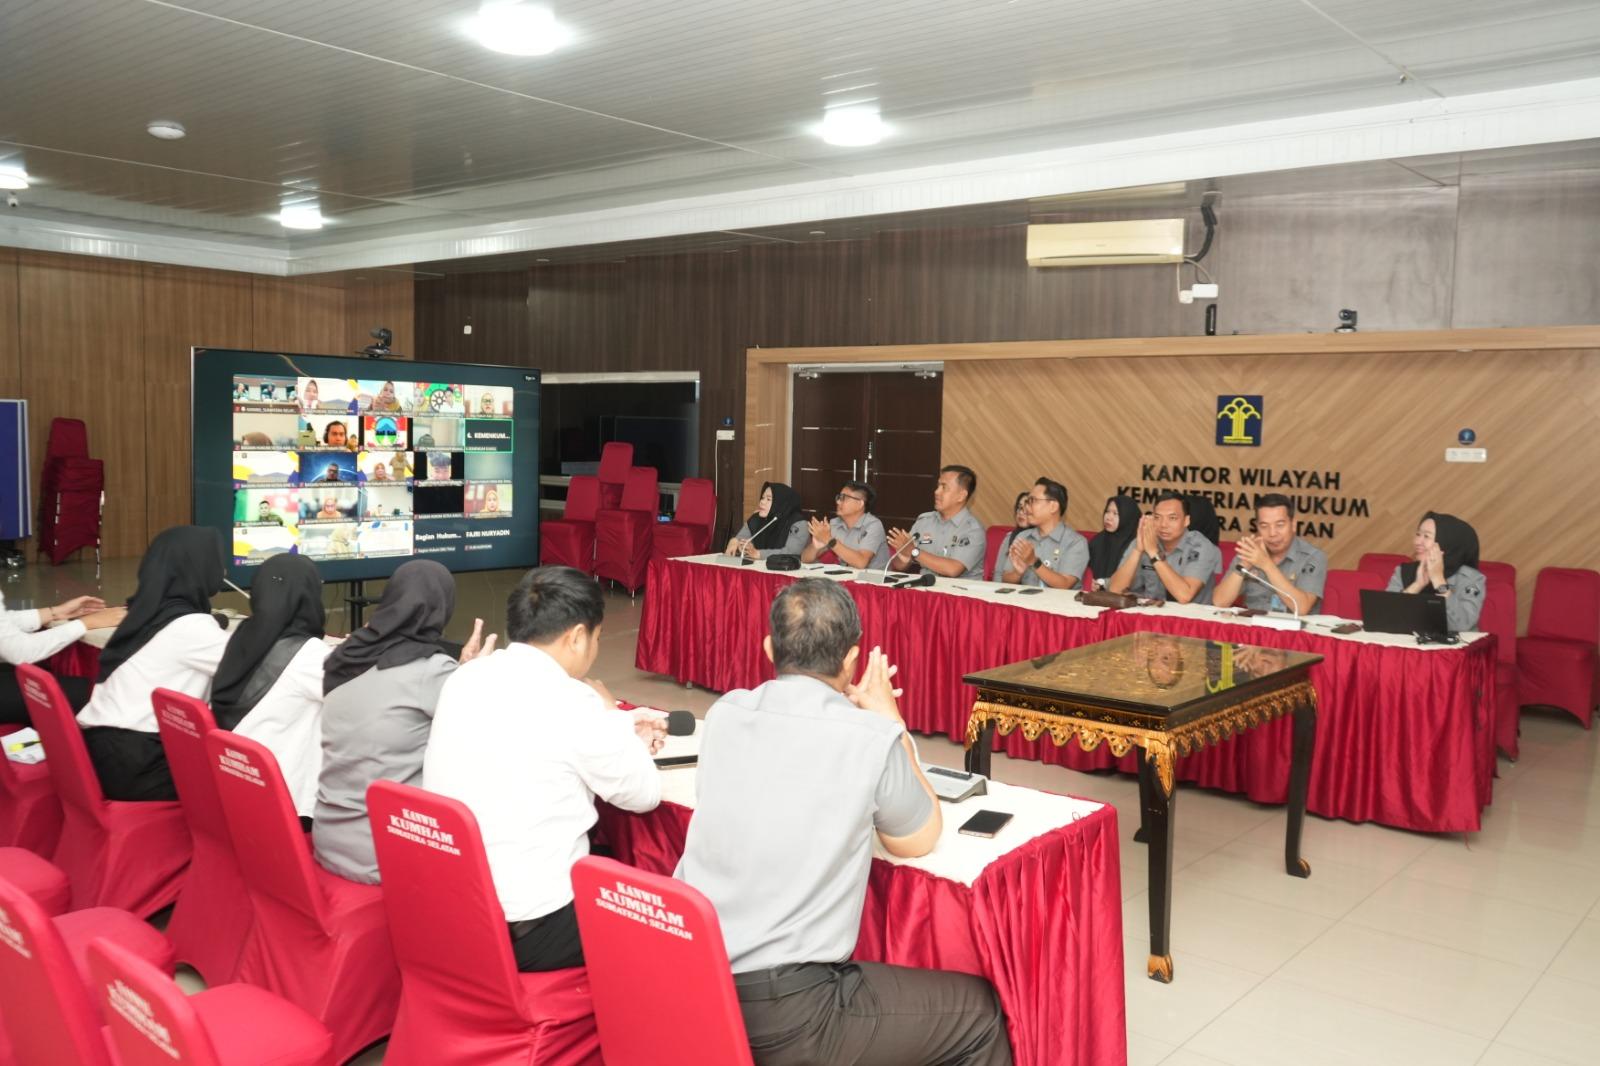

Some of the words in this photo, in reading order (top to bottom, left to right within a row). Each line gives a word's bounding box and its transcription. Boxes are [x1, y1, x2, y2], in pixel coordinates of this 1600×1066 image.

[1142, 464, 1231, 485] KANTOR
[1240, 468, 1341, 490] WILAYAH
[1117, 486, 1262, 510] KEMRIA
[1249, 518, 1334, 539] STAN
[389, 815, 454, 845] KUMHAM
[402, 808, 439, 829] KANWIL
[599, 886, 684, 928] KUMHAM
[615, 881, 666, 908] KANWIL
[595, 898, 648, 925] SUMATERA
[649, 919, 693, 941] SELATAN
